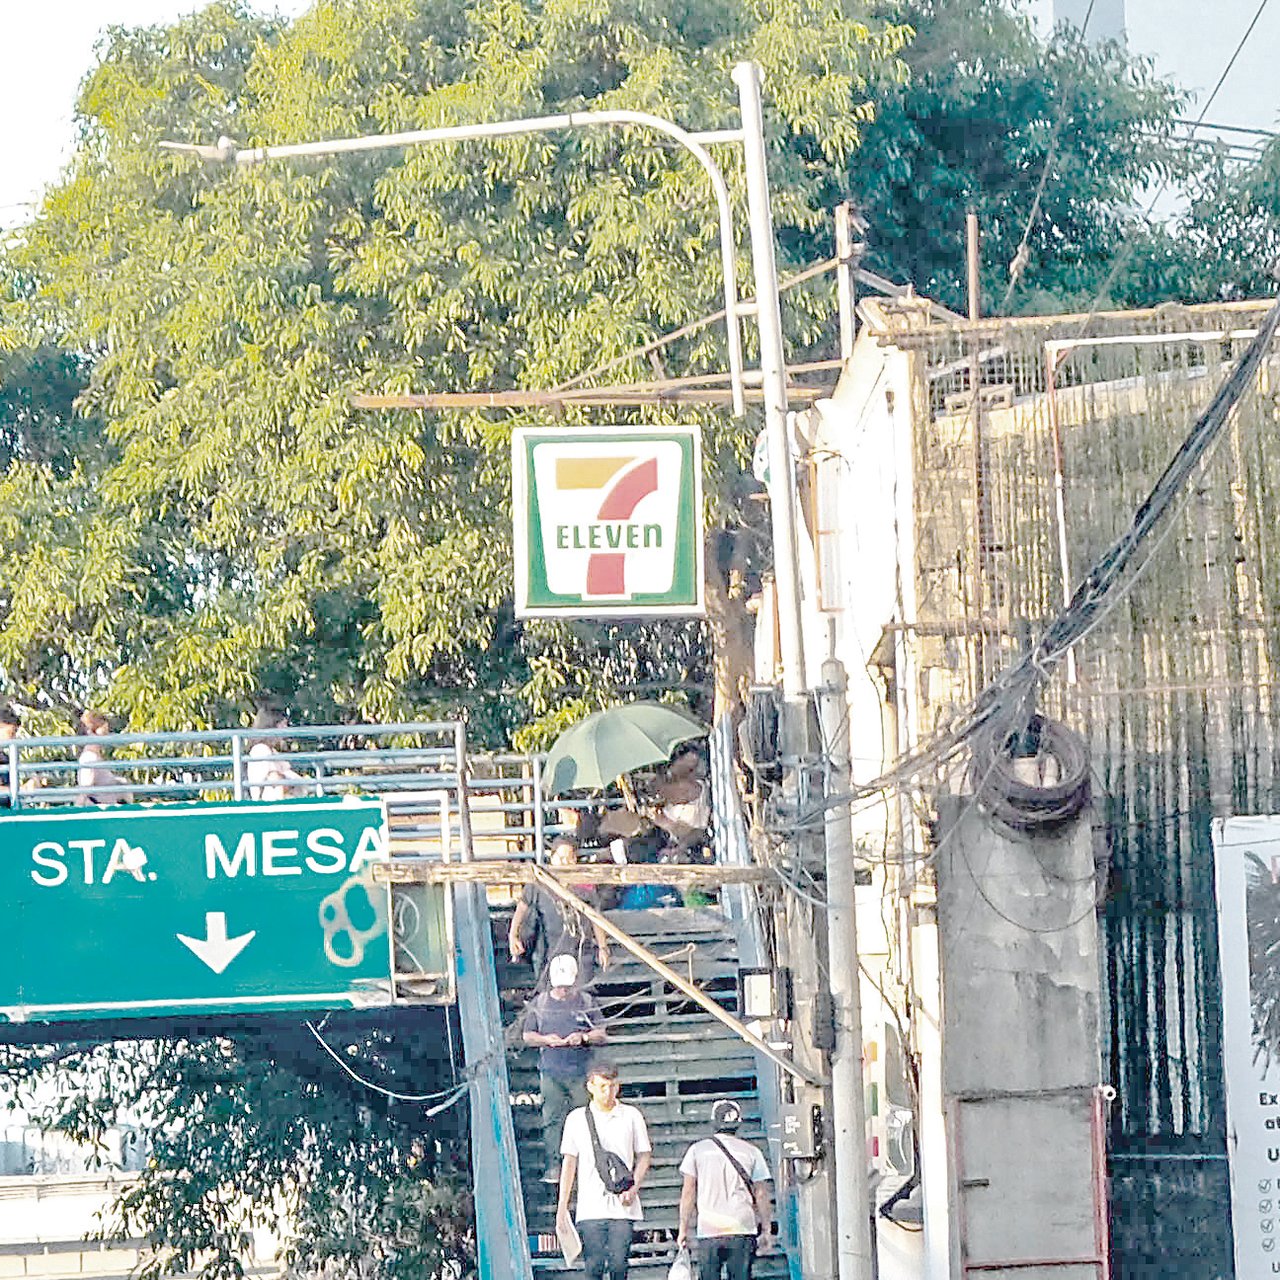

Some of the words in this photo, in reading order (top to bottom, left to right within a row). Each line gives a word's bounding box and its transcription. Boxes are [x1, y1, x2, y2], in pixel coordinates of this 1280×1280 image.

[555, 456, 658, 595] 7
[31, 837, 158, 887] STA.
[204, 825, 387, 879] MESA
